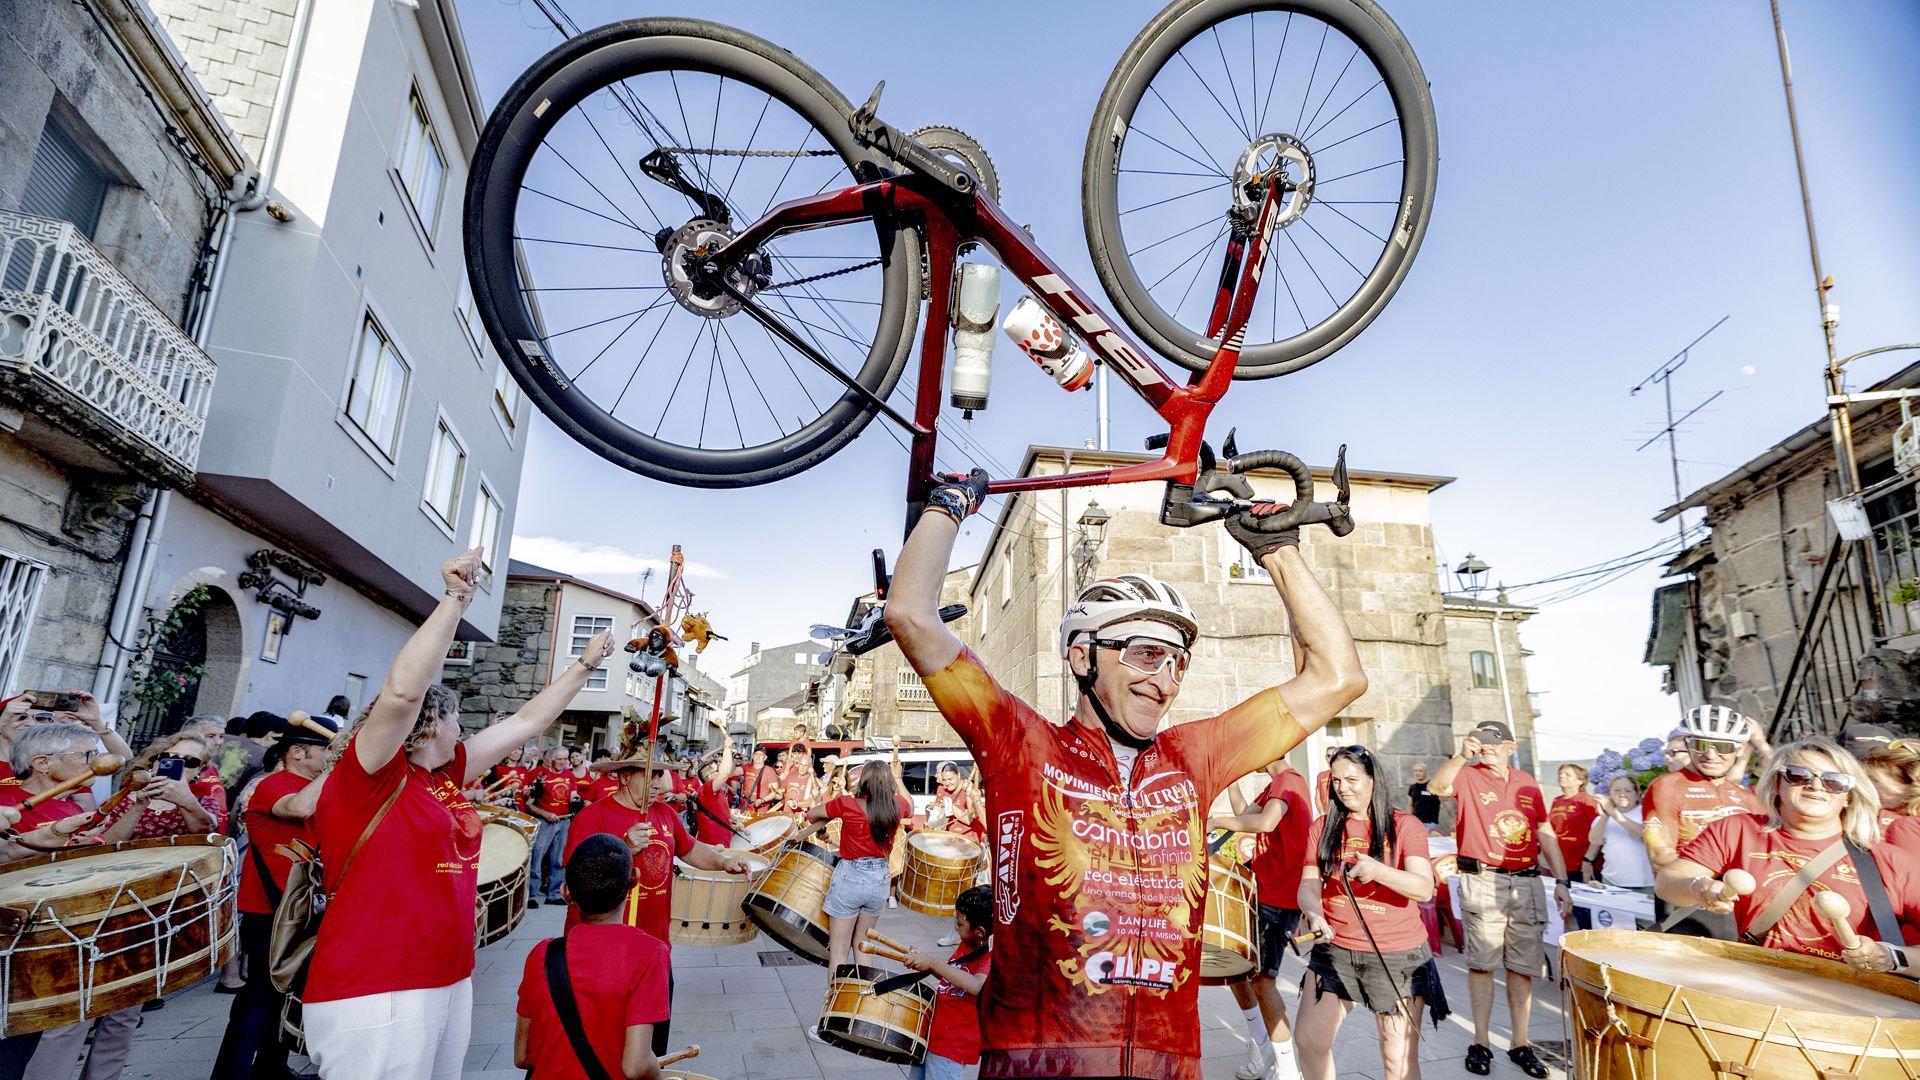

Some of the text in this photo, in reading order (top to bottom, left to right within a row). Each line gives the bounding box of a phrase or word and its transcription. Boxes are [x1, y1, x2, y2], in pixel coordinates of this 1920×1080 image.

[1031, 273, 1165, 386] BH
[1072, 819, 1191, 850] cantabria
[1083, 869, 1184, 889] red eléctrica
[1082, 884, 1103, 896] Una
[1118, 916, 1167, 929] LAND LIFE
[1155, 931, 1182, 941] MISIÓN
